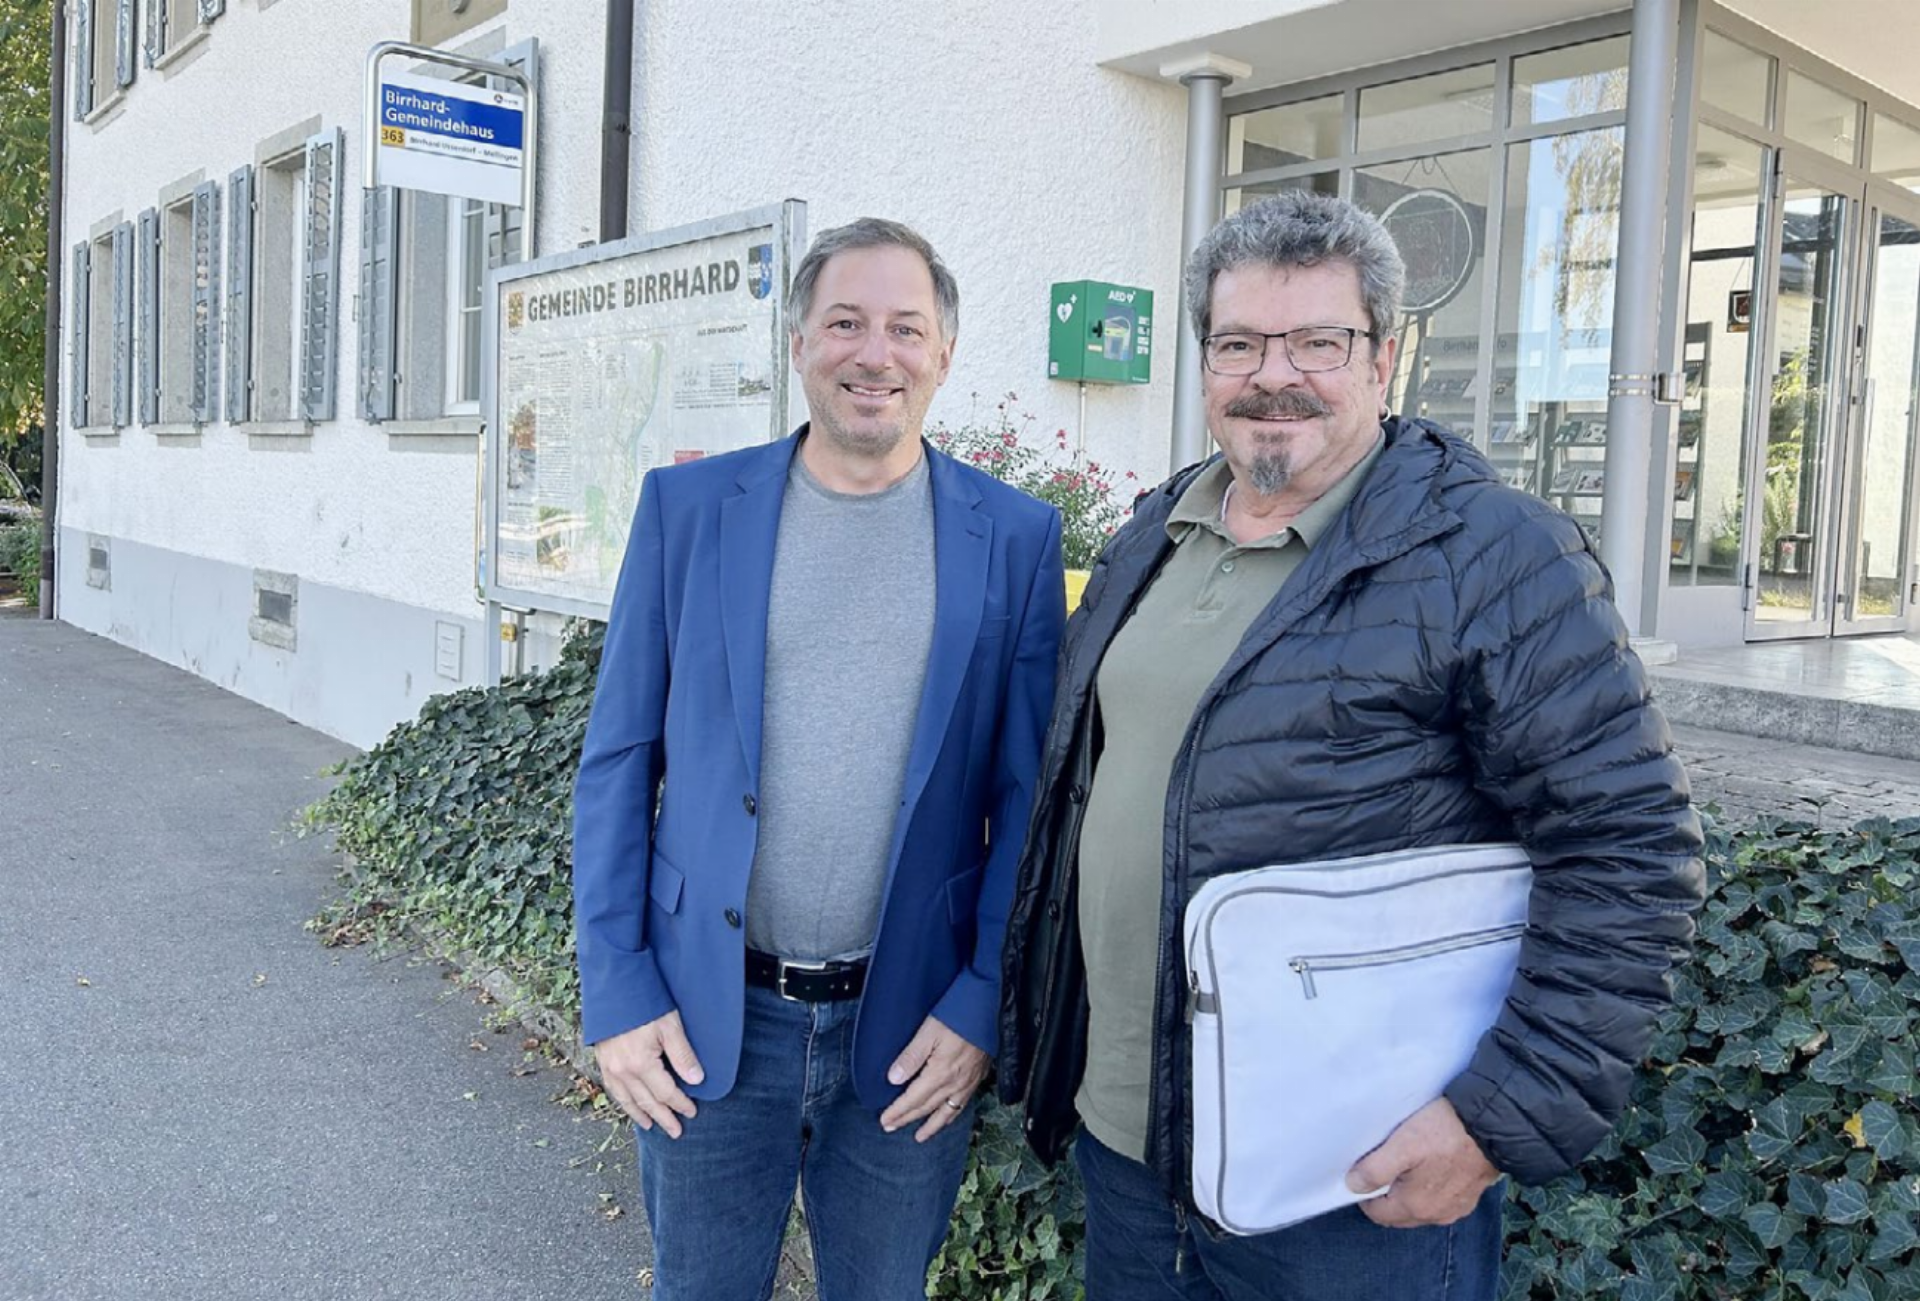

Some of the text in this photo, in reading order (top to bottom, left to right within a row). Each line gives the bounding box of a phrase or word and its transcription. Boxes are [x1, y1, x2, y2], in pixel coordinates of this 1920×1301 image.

[385, 89, 450, 114] Birrhard-
[381, 128, 405, 144] 363
[385, 107, 495, 140] Gemeindehaus
[528, 259, 741, 322] GEMEINDE BIRRHARD
[1108, 290, 1127, 303] AED
